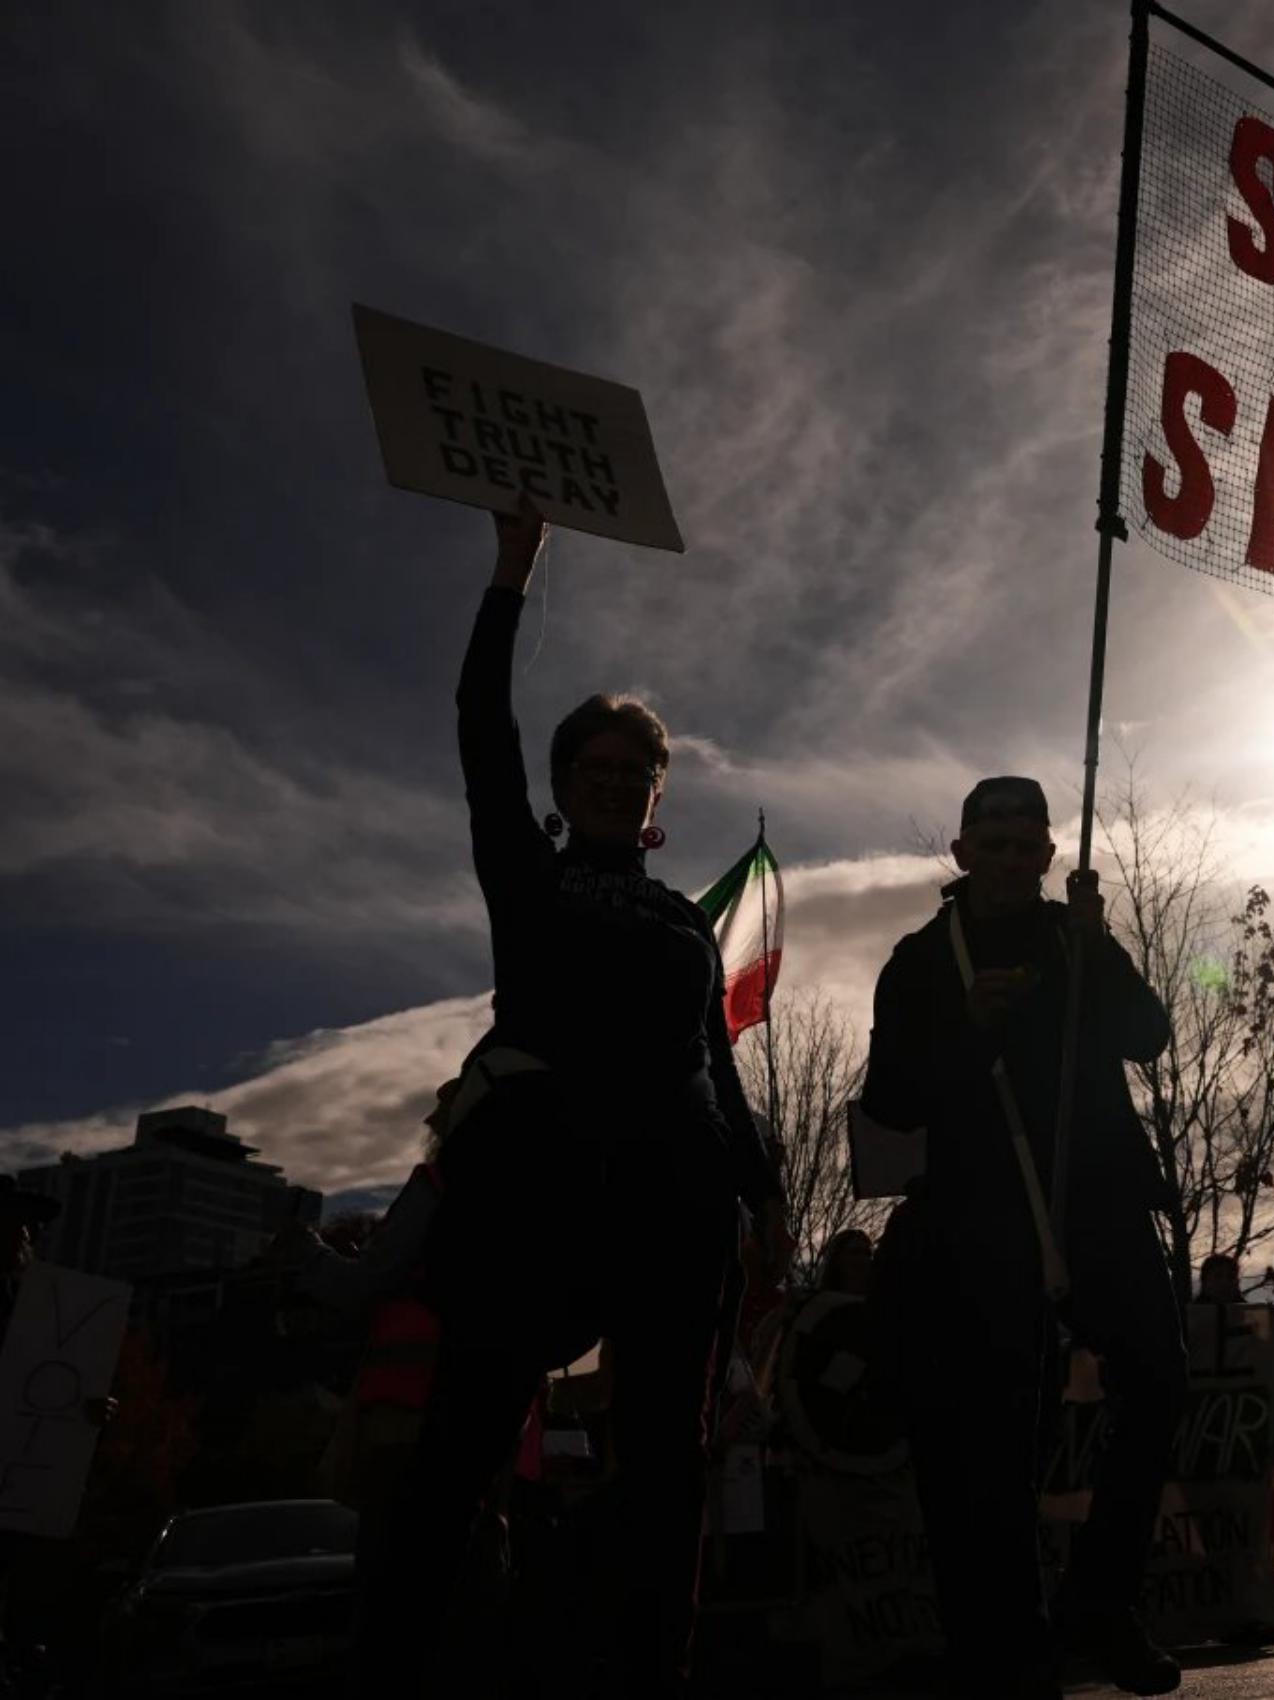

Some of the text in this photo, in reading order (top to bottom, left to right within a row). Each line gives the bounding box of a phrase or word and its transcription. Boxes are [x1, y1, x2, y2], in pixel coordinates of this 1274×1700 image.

[421, 365, 598, 444] FIGHT
[431, 404, 616, 484] TRUTH
[440, 443, 620, 516] DECAY
